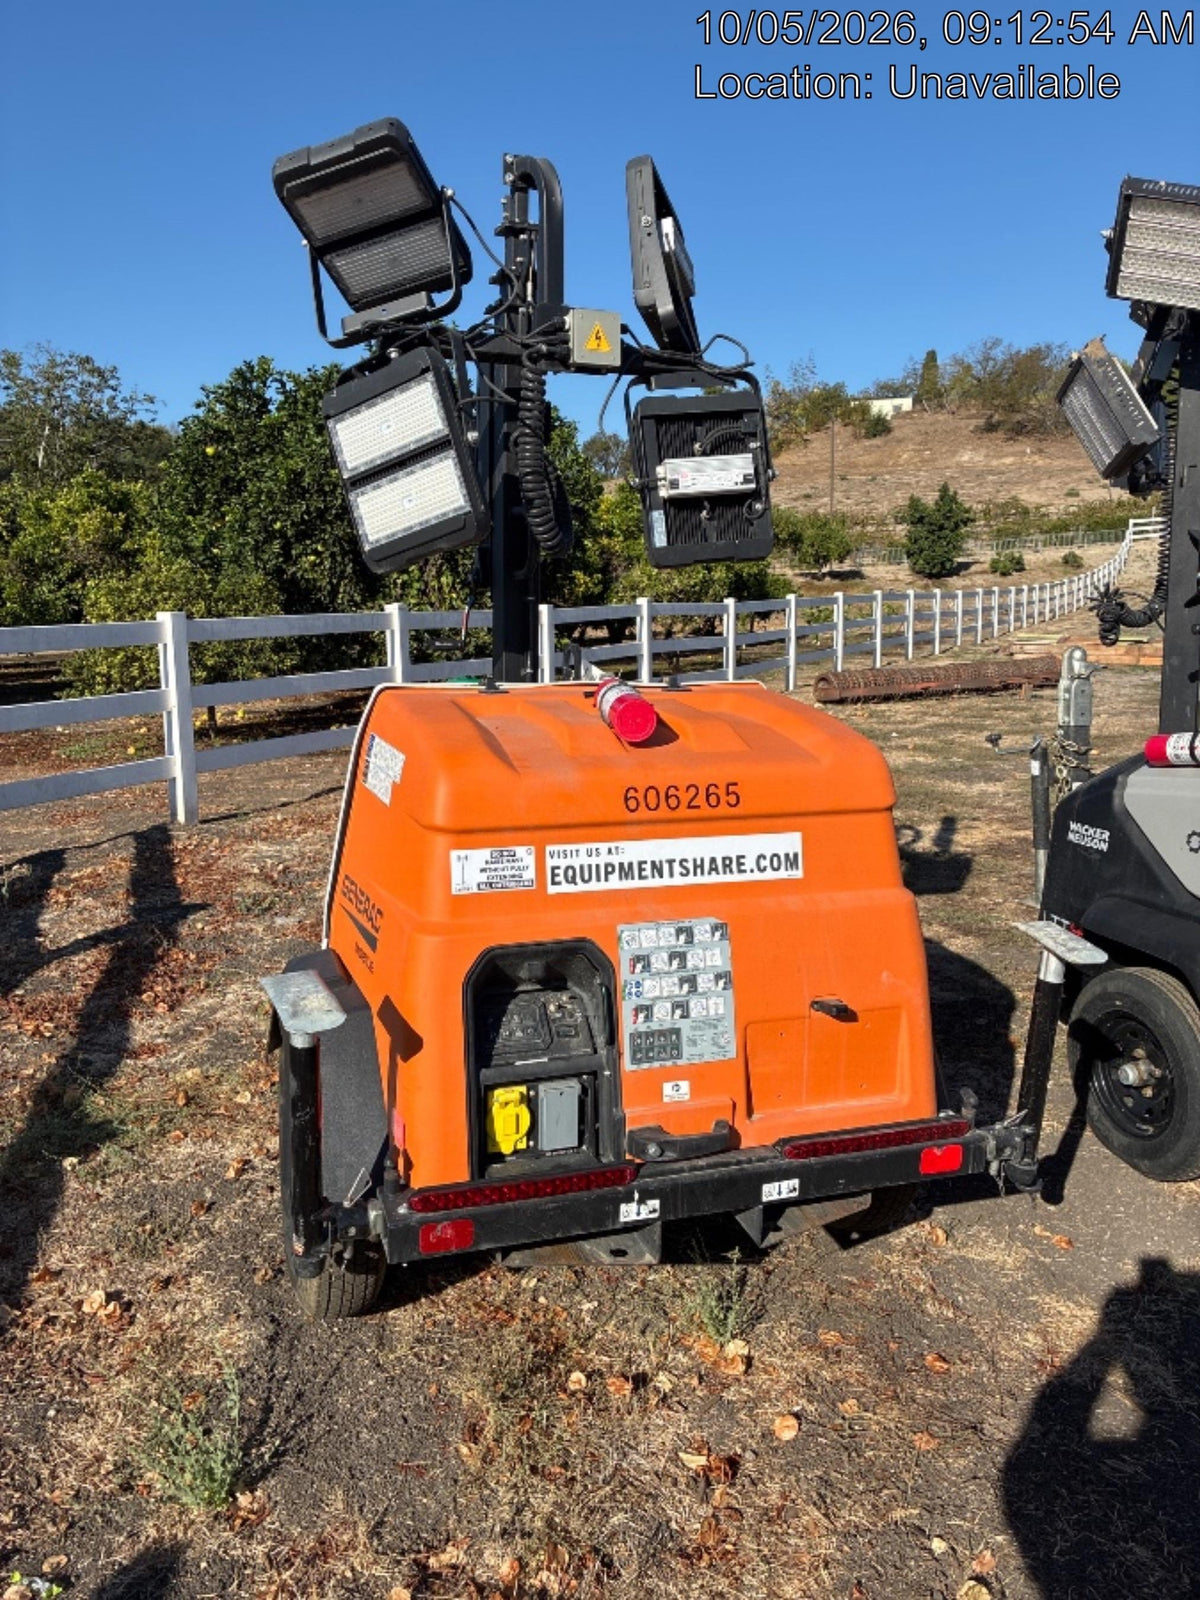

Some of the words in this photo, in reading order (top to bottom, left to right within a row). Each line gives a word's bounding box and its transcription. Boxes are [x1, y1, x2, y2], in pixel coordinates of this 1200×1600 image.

[624, 782, 741, 812] 606265
[1067, 831, 1109, 852] NEUSON
[1069, 821, 1111, 842] WACKER
[549, 849, 580, 859] VISIT
[586, 847, 601, 857] US
[550, 851, 800, 886] EQUIPMENTSHARE.COM
